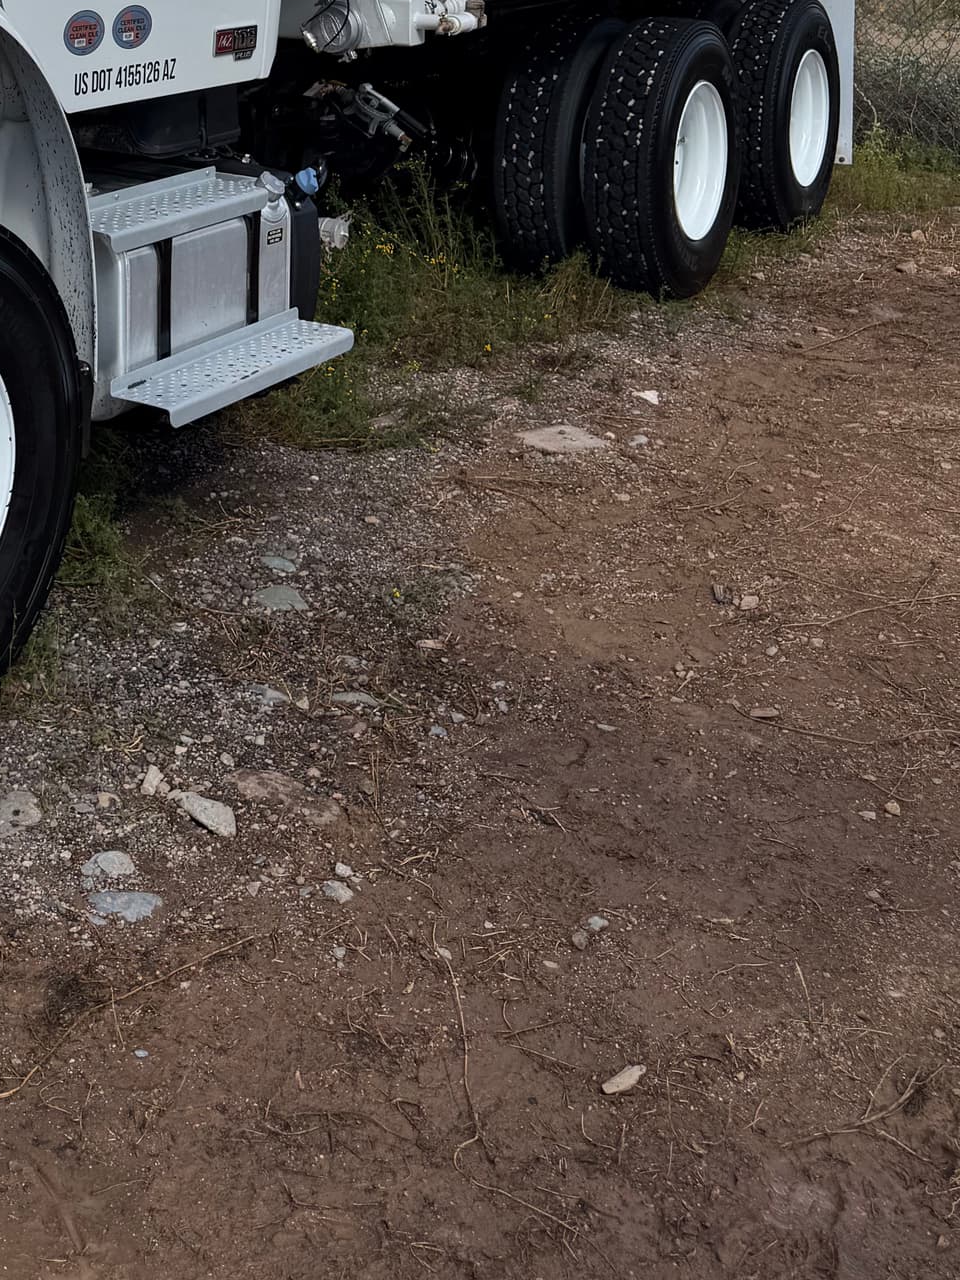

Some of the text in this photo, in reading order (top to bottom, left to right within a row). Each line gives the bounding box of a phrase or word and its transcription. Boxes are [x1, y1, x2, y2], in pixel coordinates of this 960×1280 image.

[74, 58, 177, 96] US DOT 4155126 AZ
